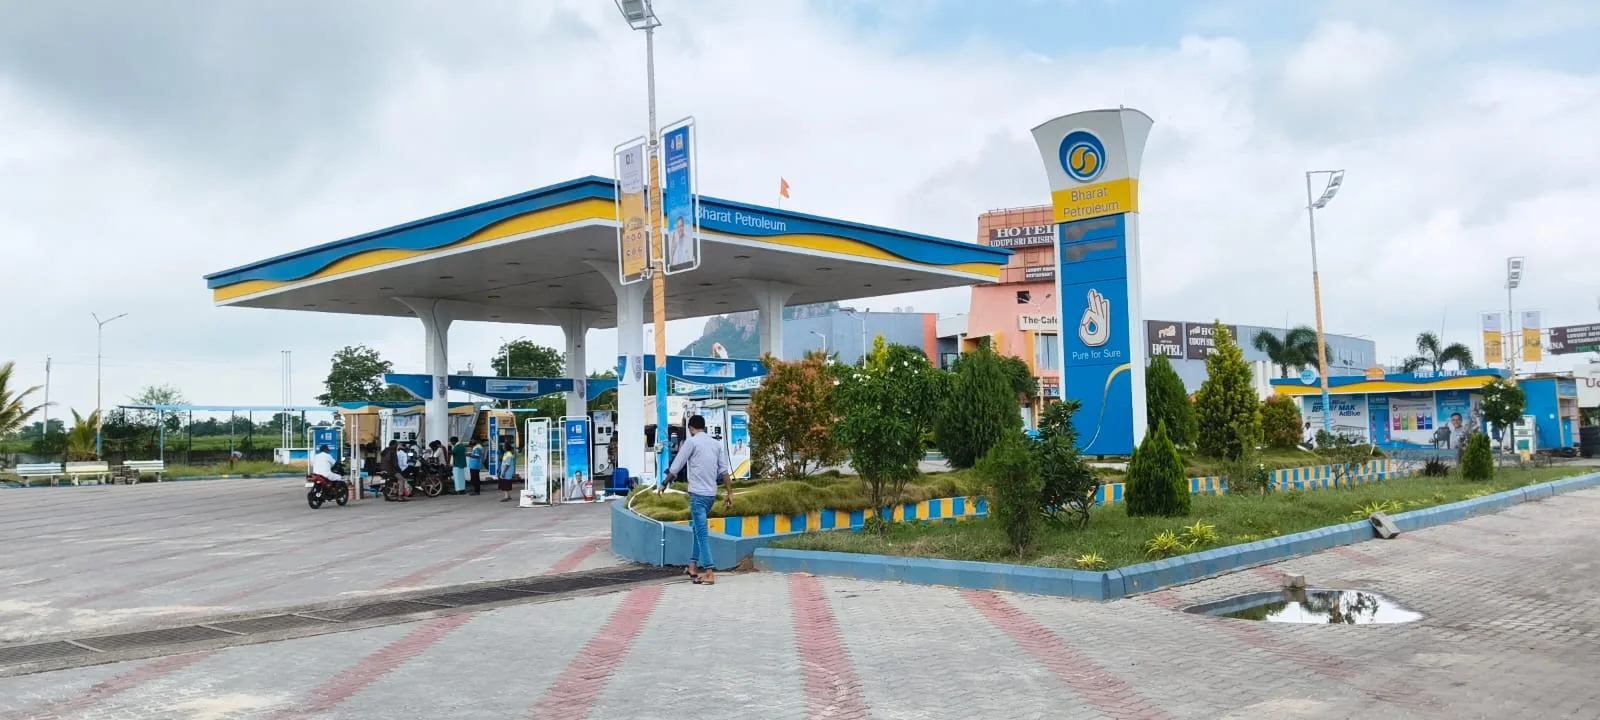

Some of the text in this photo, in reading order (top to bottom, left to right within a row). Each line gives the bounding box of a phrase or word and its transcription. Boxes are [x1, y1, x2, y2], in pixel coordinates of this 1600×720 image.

[1071, 187, 1108, 202] Bharat
[1063, 200, 1119, 218] Petroleum
[695, 205, 787, 232] Bharat Petroleum
[997, 225, 1055, 238] HOTEL
[990, 235, 1055, 247] UDUPI SRI KRISHN
[1072, 349, 1121, 361] Pure for Sure
[1152, 343, 1183, 356] HOTEL
[1413, 371, 1435, 379] FREE
